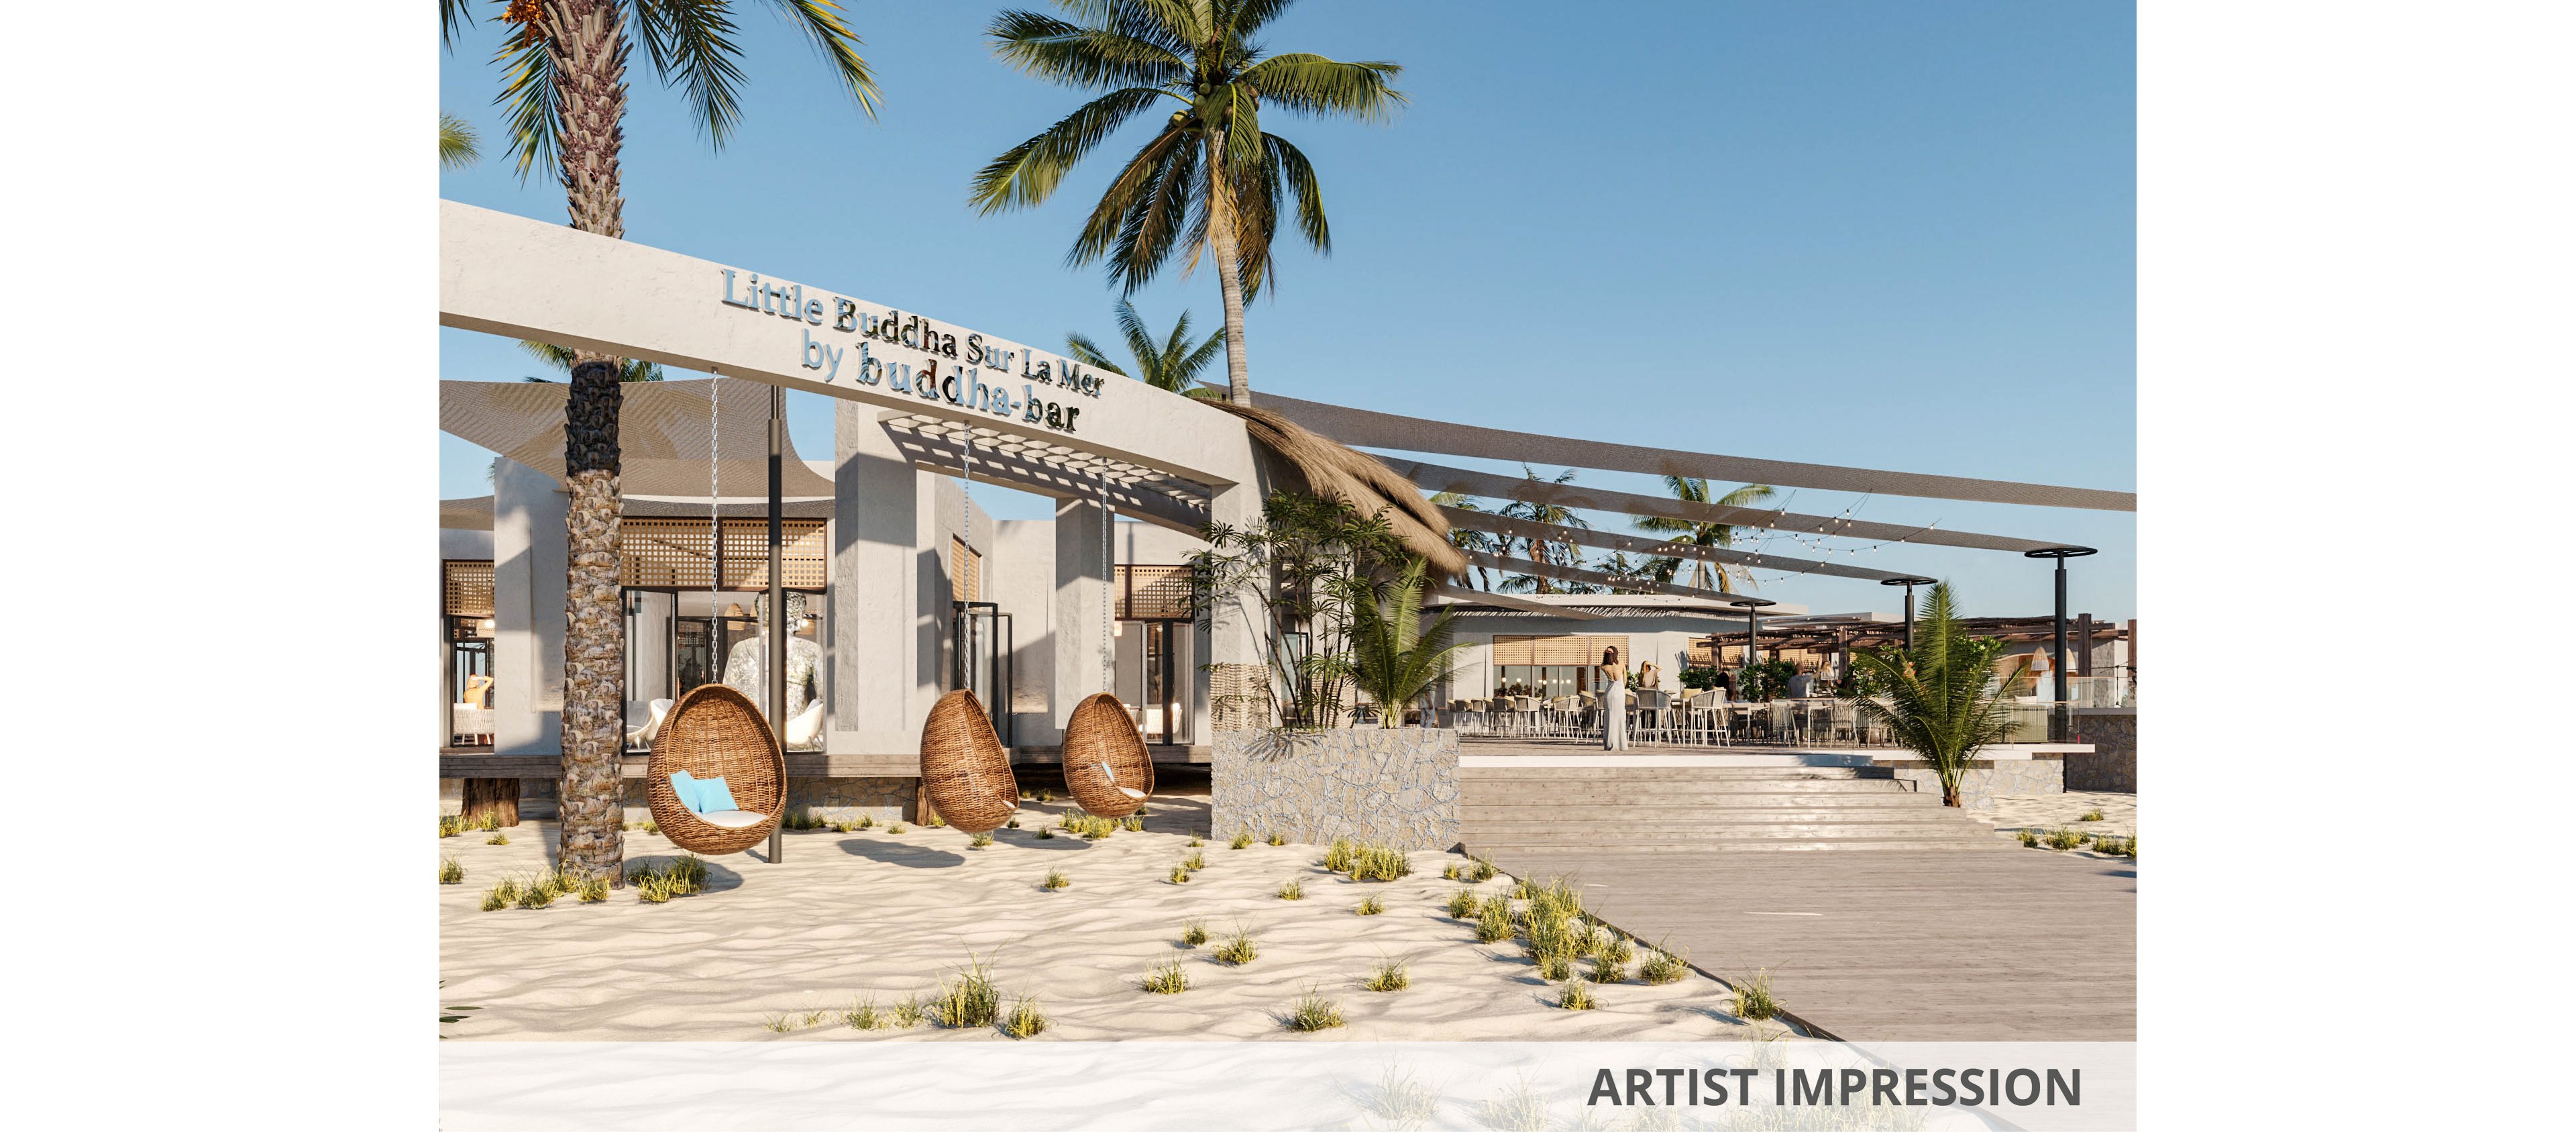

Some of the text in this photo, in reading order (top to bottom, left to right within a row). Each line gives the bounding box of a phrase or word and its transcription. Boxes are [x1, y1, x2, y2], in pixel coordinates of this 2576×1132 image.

[720, 268, 1106, 397] Little Buddha Sur La Mer
[801, 328, 1080, 432] by buddha-bar
